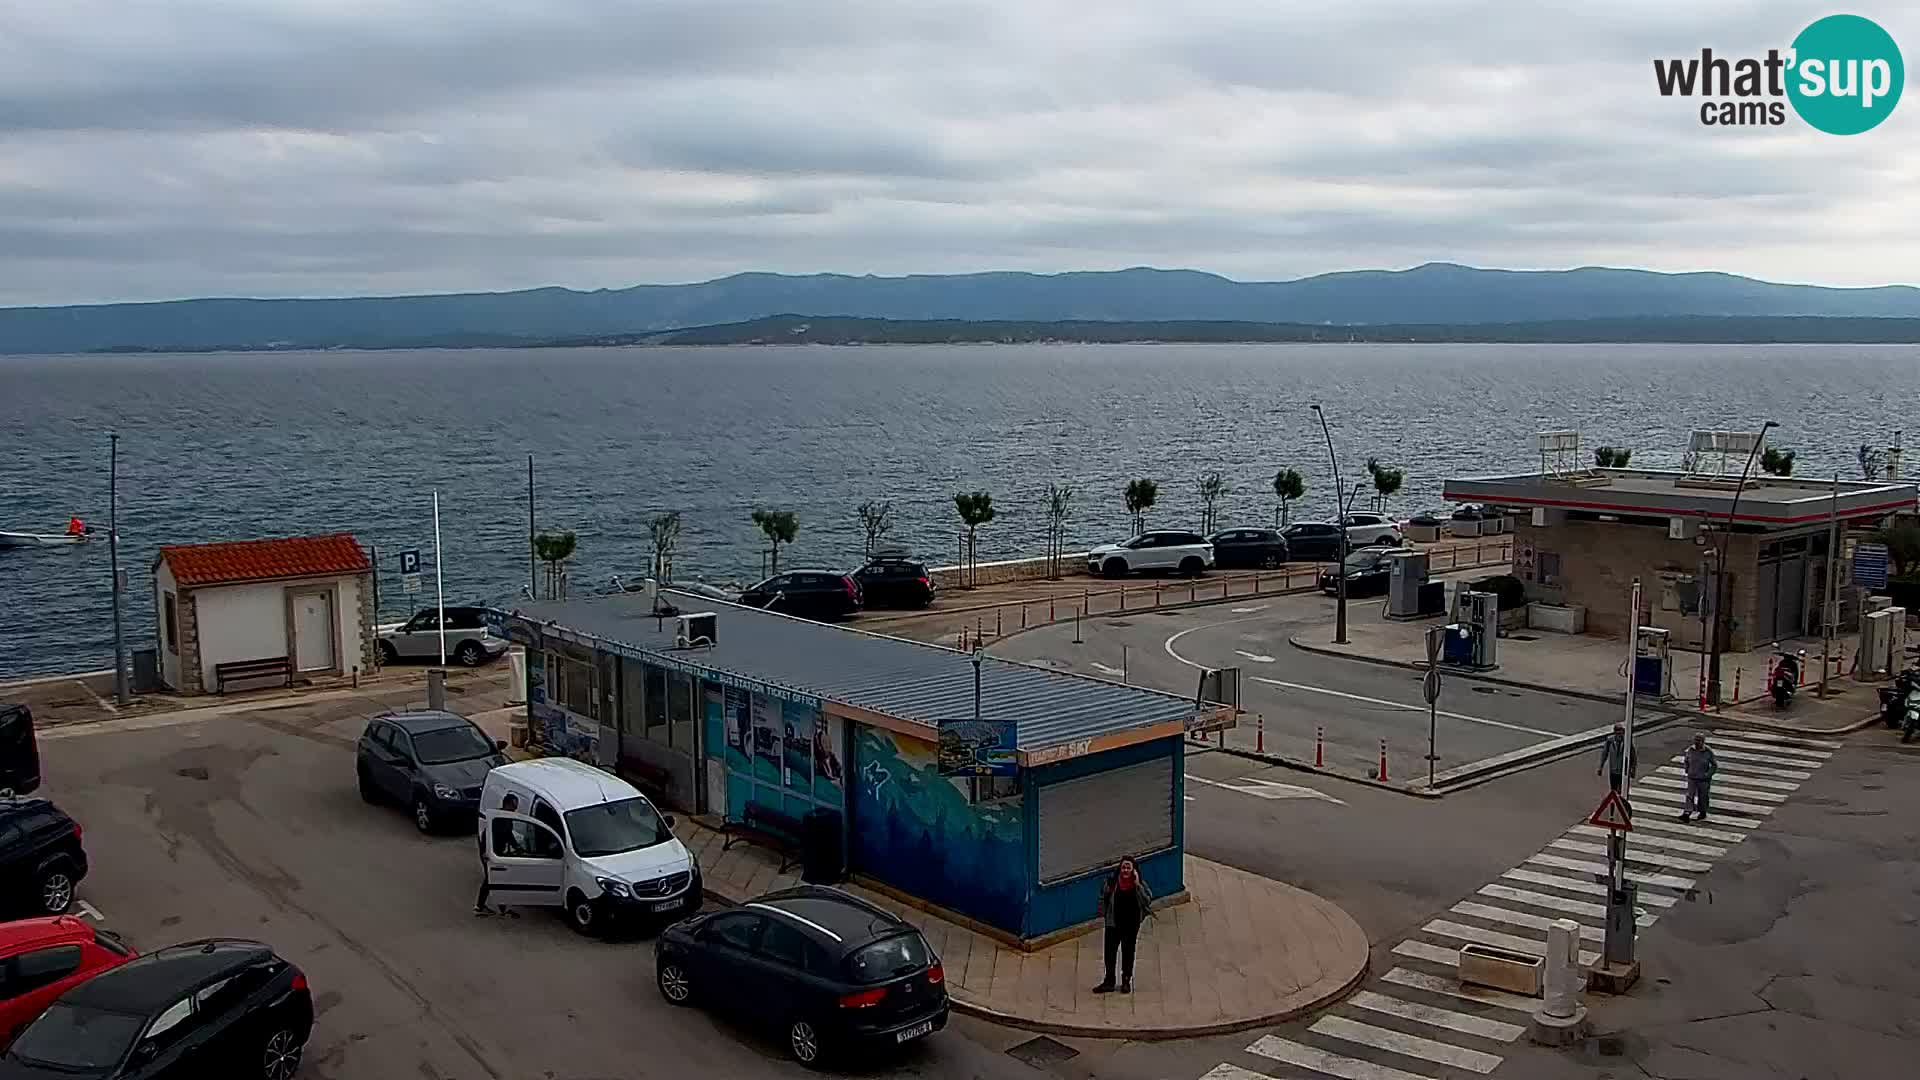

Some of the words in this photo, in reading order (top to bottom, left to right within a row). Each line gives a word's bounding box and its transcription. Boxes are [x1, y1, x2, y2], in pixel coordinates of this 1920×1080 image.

[404, 553, 416, 572] P
[734, 678, 766, 694] STATION
[767, 686, 791, 702] TICKET
[792, 693, 817, 708] OFFICE
